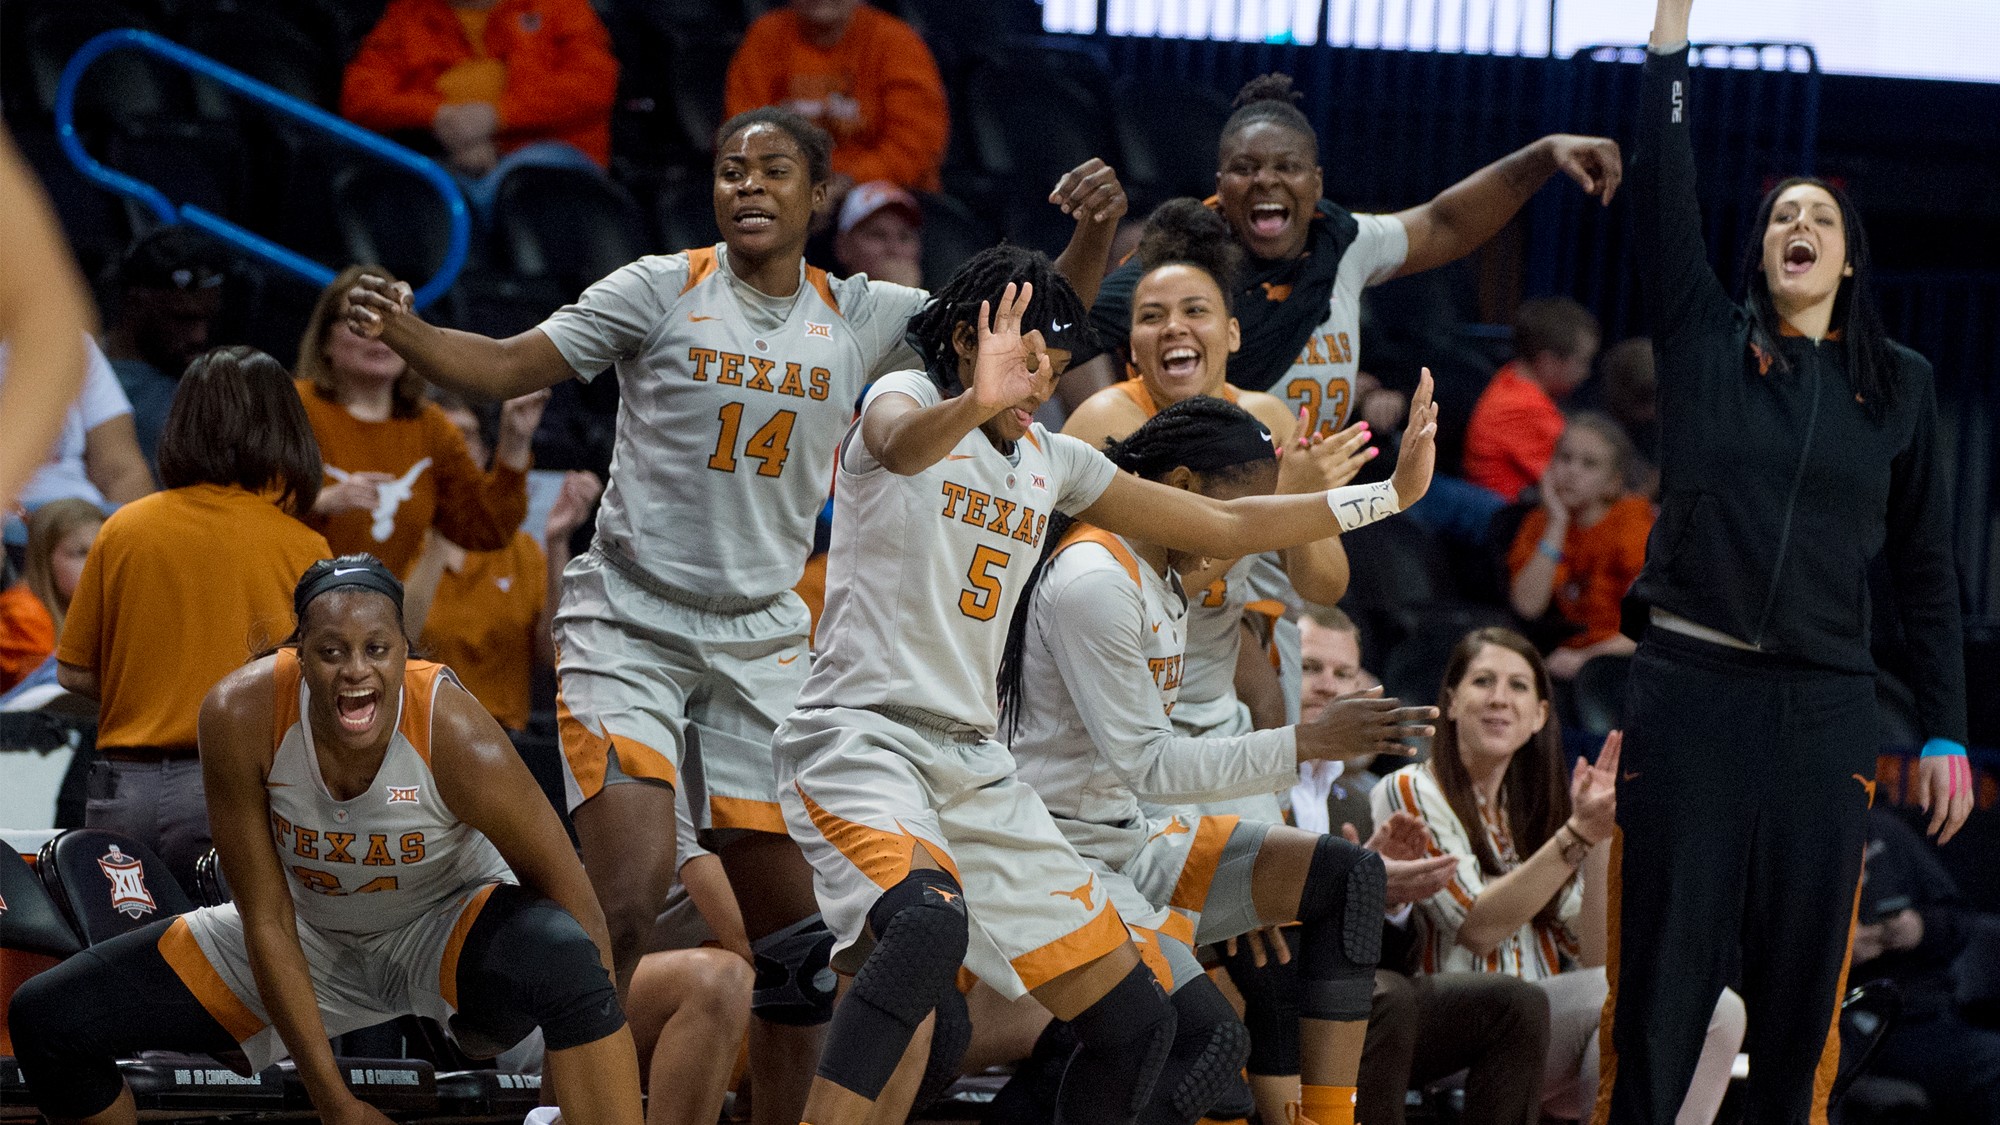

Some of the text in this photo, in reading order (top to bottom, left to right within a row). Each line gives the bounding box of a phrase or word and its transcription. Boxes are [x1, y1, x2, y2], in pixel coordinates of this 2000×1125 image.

[688, 347, 831, 401] TEXAS
[1296, 332, 1352, 365] XAS
[1287, 377, 1350, 441] 33
[707, 401, 798, 478] 14
[942, 480, 1047, 549] TEXAS
[958, 544, 1011, 622] 5
[388, 787, 419, 803] XII
[272, 811, 426, 866] TEXAS
[103, 865, 151, 902] XII
[174, 1069, 192, 1085] BIG
[350, 1069, 365, 1085] BIG
[375, 1069, 420, 1085] CONFERENCE
